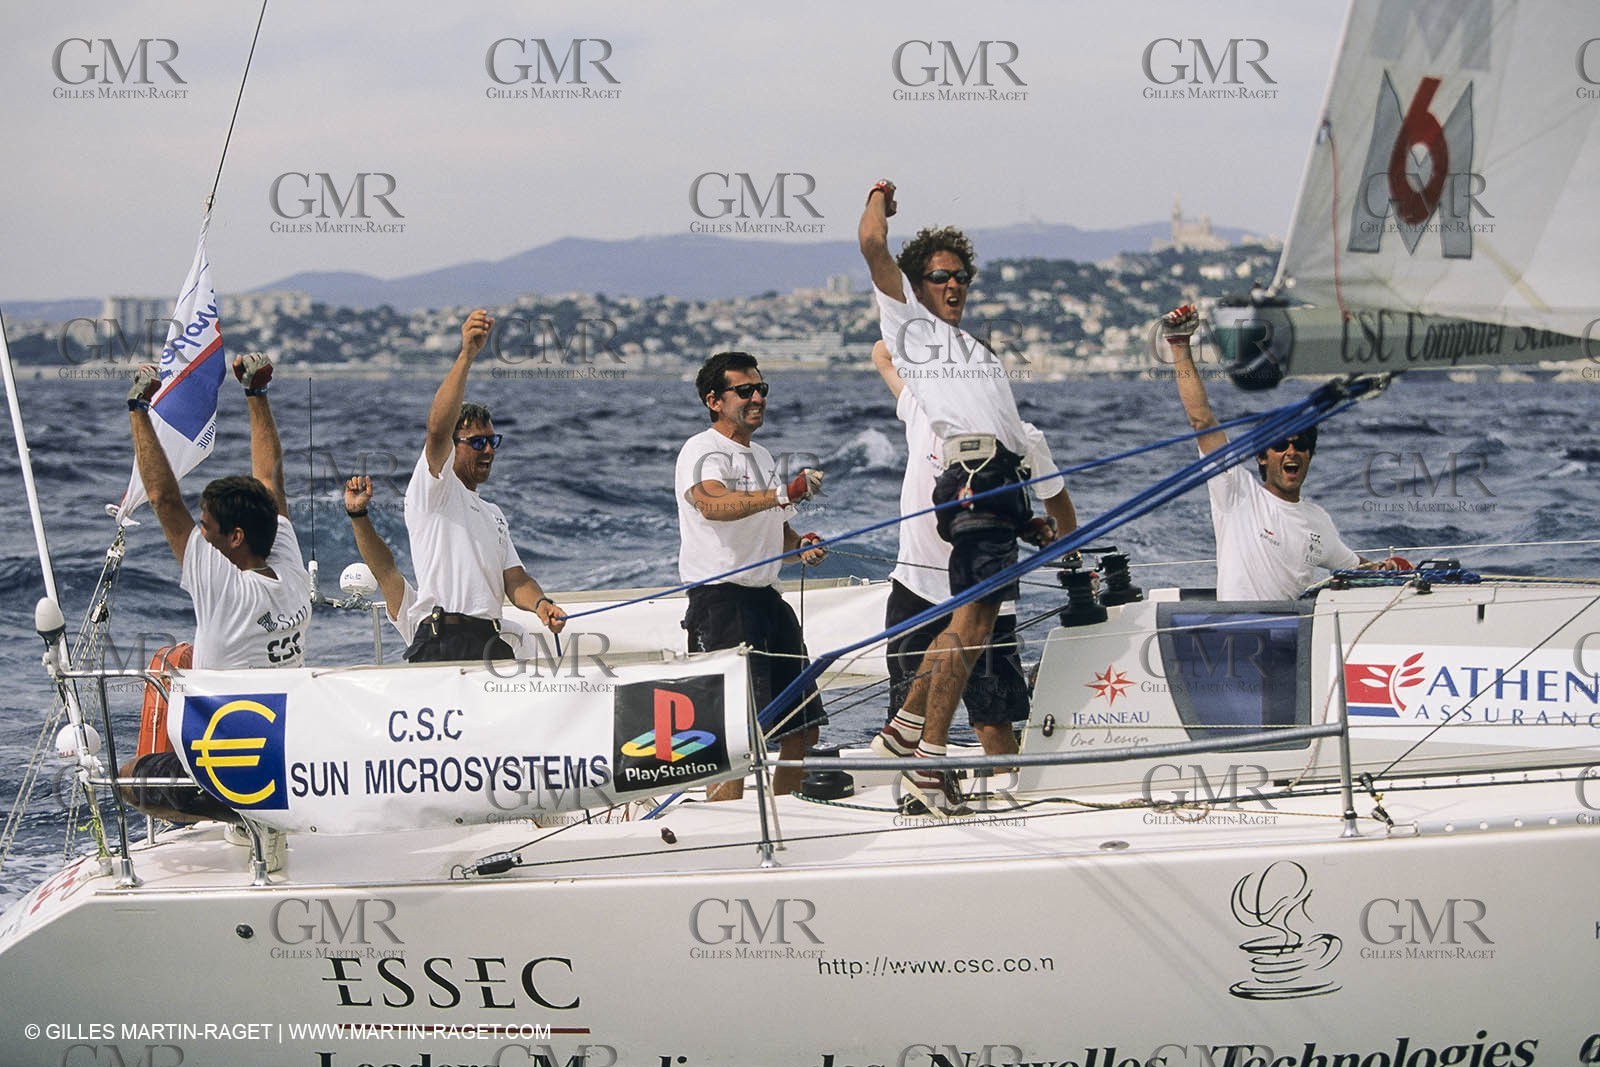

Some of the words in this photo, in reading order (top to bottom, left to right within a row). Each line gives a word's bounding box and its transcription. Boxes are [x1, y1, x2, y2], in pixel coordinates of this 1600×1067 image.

[1426, 666, 1599, 704] ATHEN
[388, 707, 464, 742] C.S.C
[1072, 711, 1150, 728] JEANNEAU
[1070, 732, 1095, 747] One
[1104, 727, 1149, 748] Design
[291, 761, 349, 797] SUN
[365, 755, 609, 795] MICROSYSTEMS
[625, 761, 718, 782] PlayStation
[322, 957, 581, 1009] ESSEC
